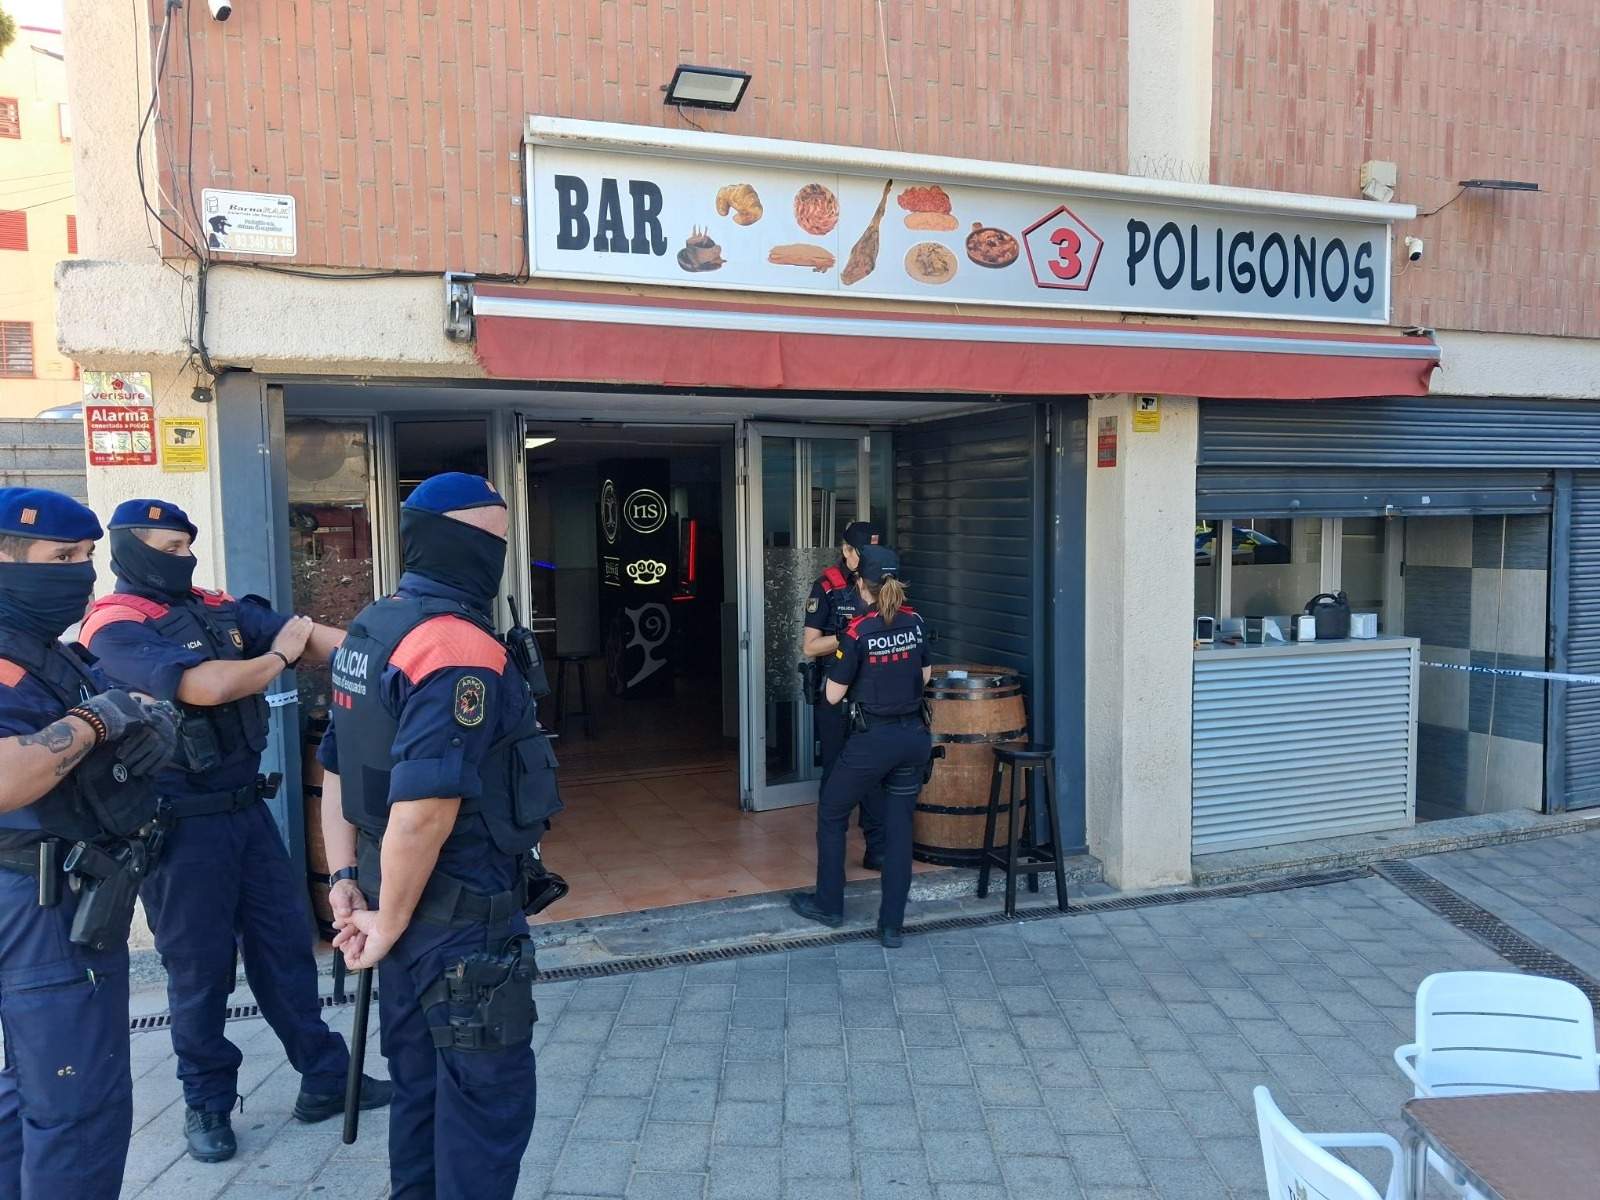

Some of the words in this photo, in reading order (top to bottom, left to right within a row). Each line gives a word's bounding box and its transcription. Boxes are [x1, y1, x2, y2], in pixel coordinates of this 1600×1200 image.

[553, 174, 668, 257] BAR
[1048, 227, 1082, 279] 3
[1127, 217, 1375, 304] POLIGONOS
[91, 391, 145, 400] verisure
[91, 409, 149, 422] Alarma
[186, 640, 202, 649] ICIA
[867, 630, 918, 650] POLICIA
[333, 646, 369, 680] POLICIA
